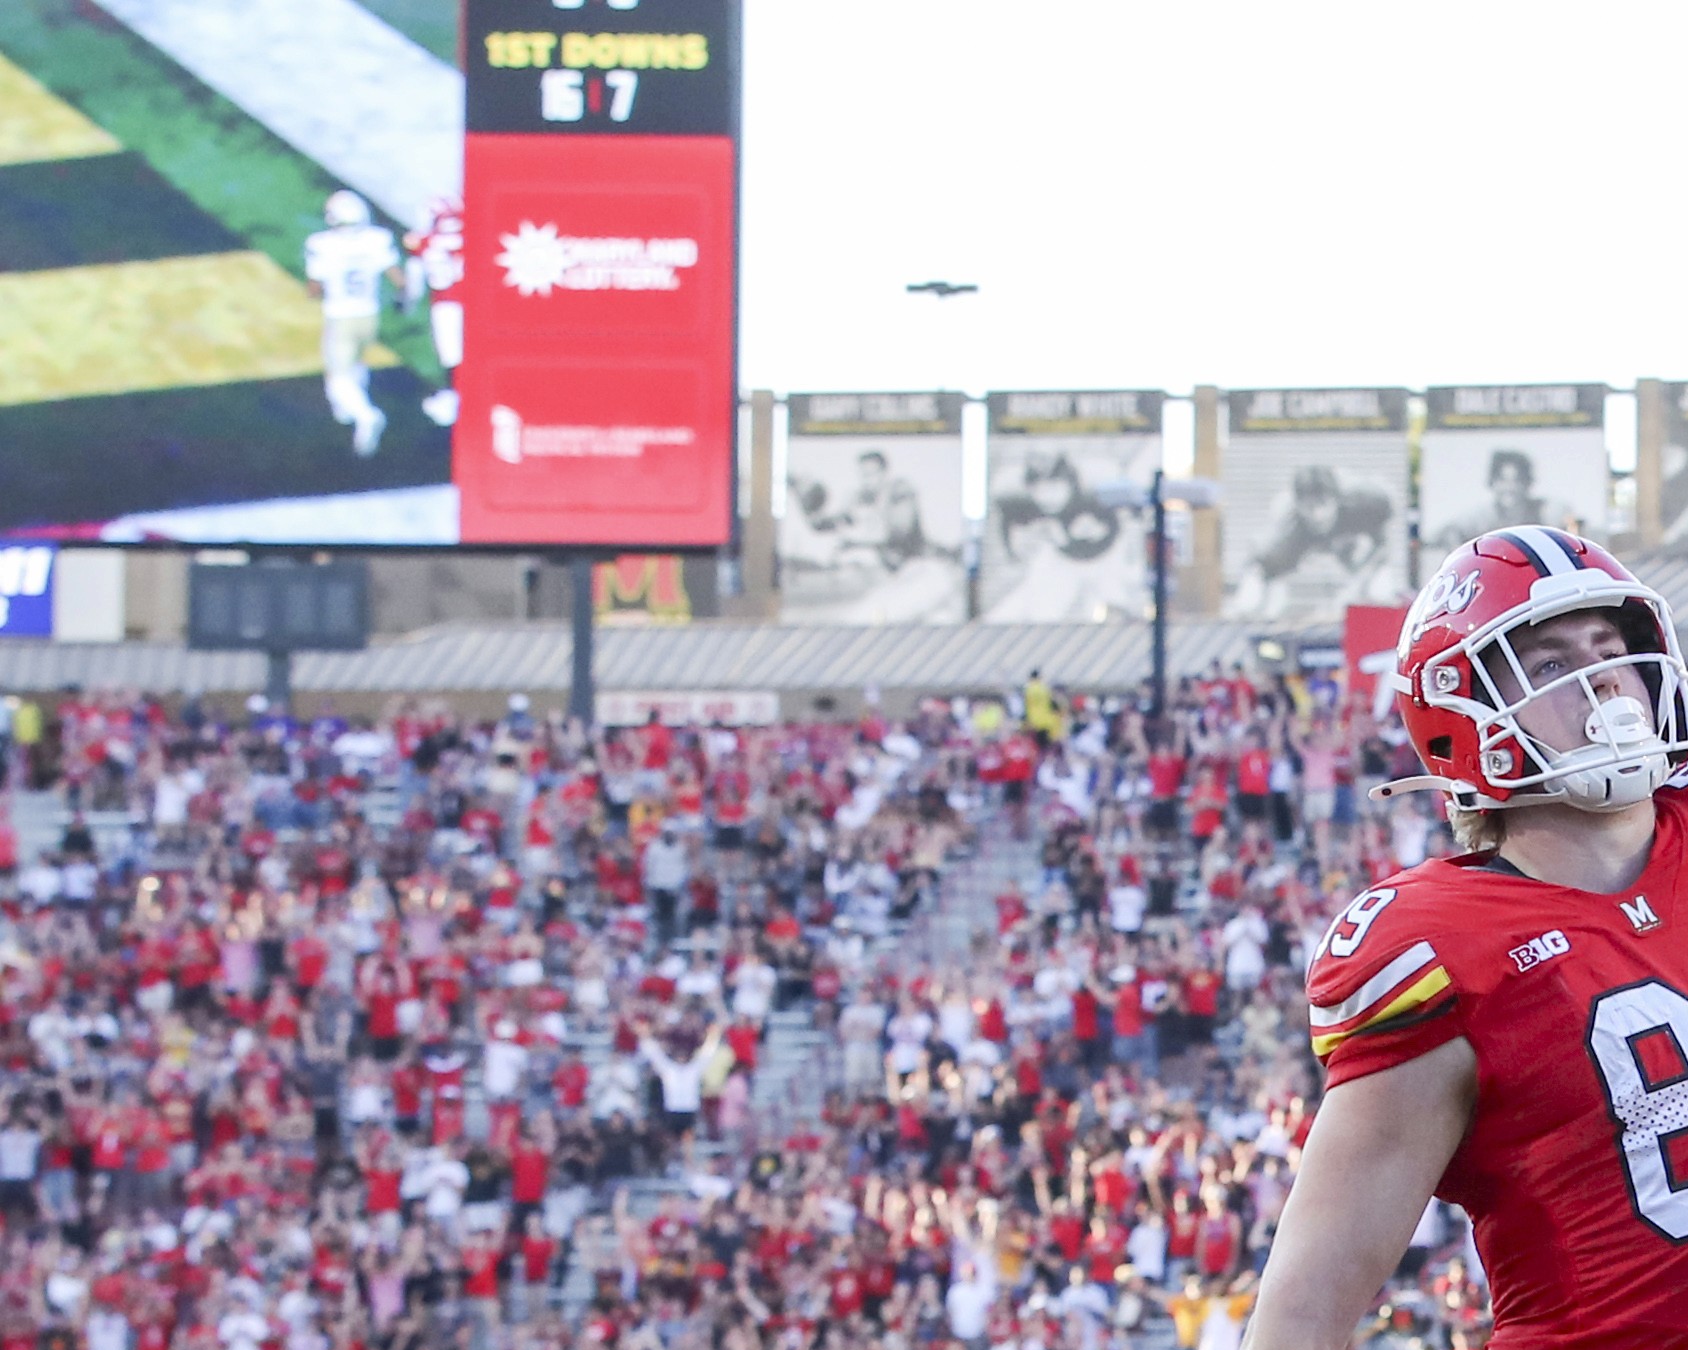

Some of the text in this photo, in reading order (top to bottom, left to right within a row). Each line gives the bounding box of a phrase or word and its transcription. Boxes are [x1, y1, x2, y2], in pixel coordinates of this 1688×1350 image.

[485, 32, 708, 70] 1ST DOWNS
[605, 69, 638, 121] 7
[1618, 894, 1659, 930] M
